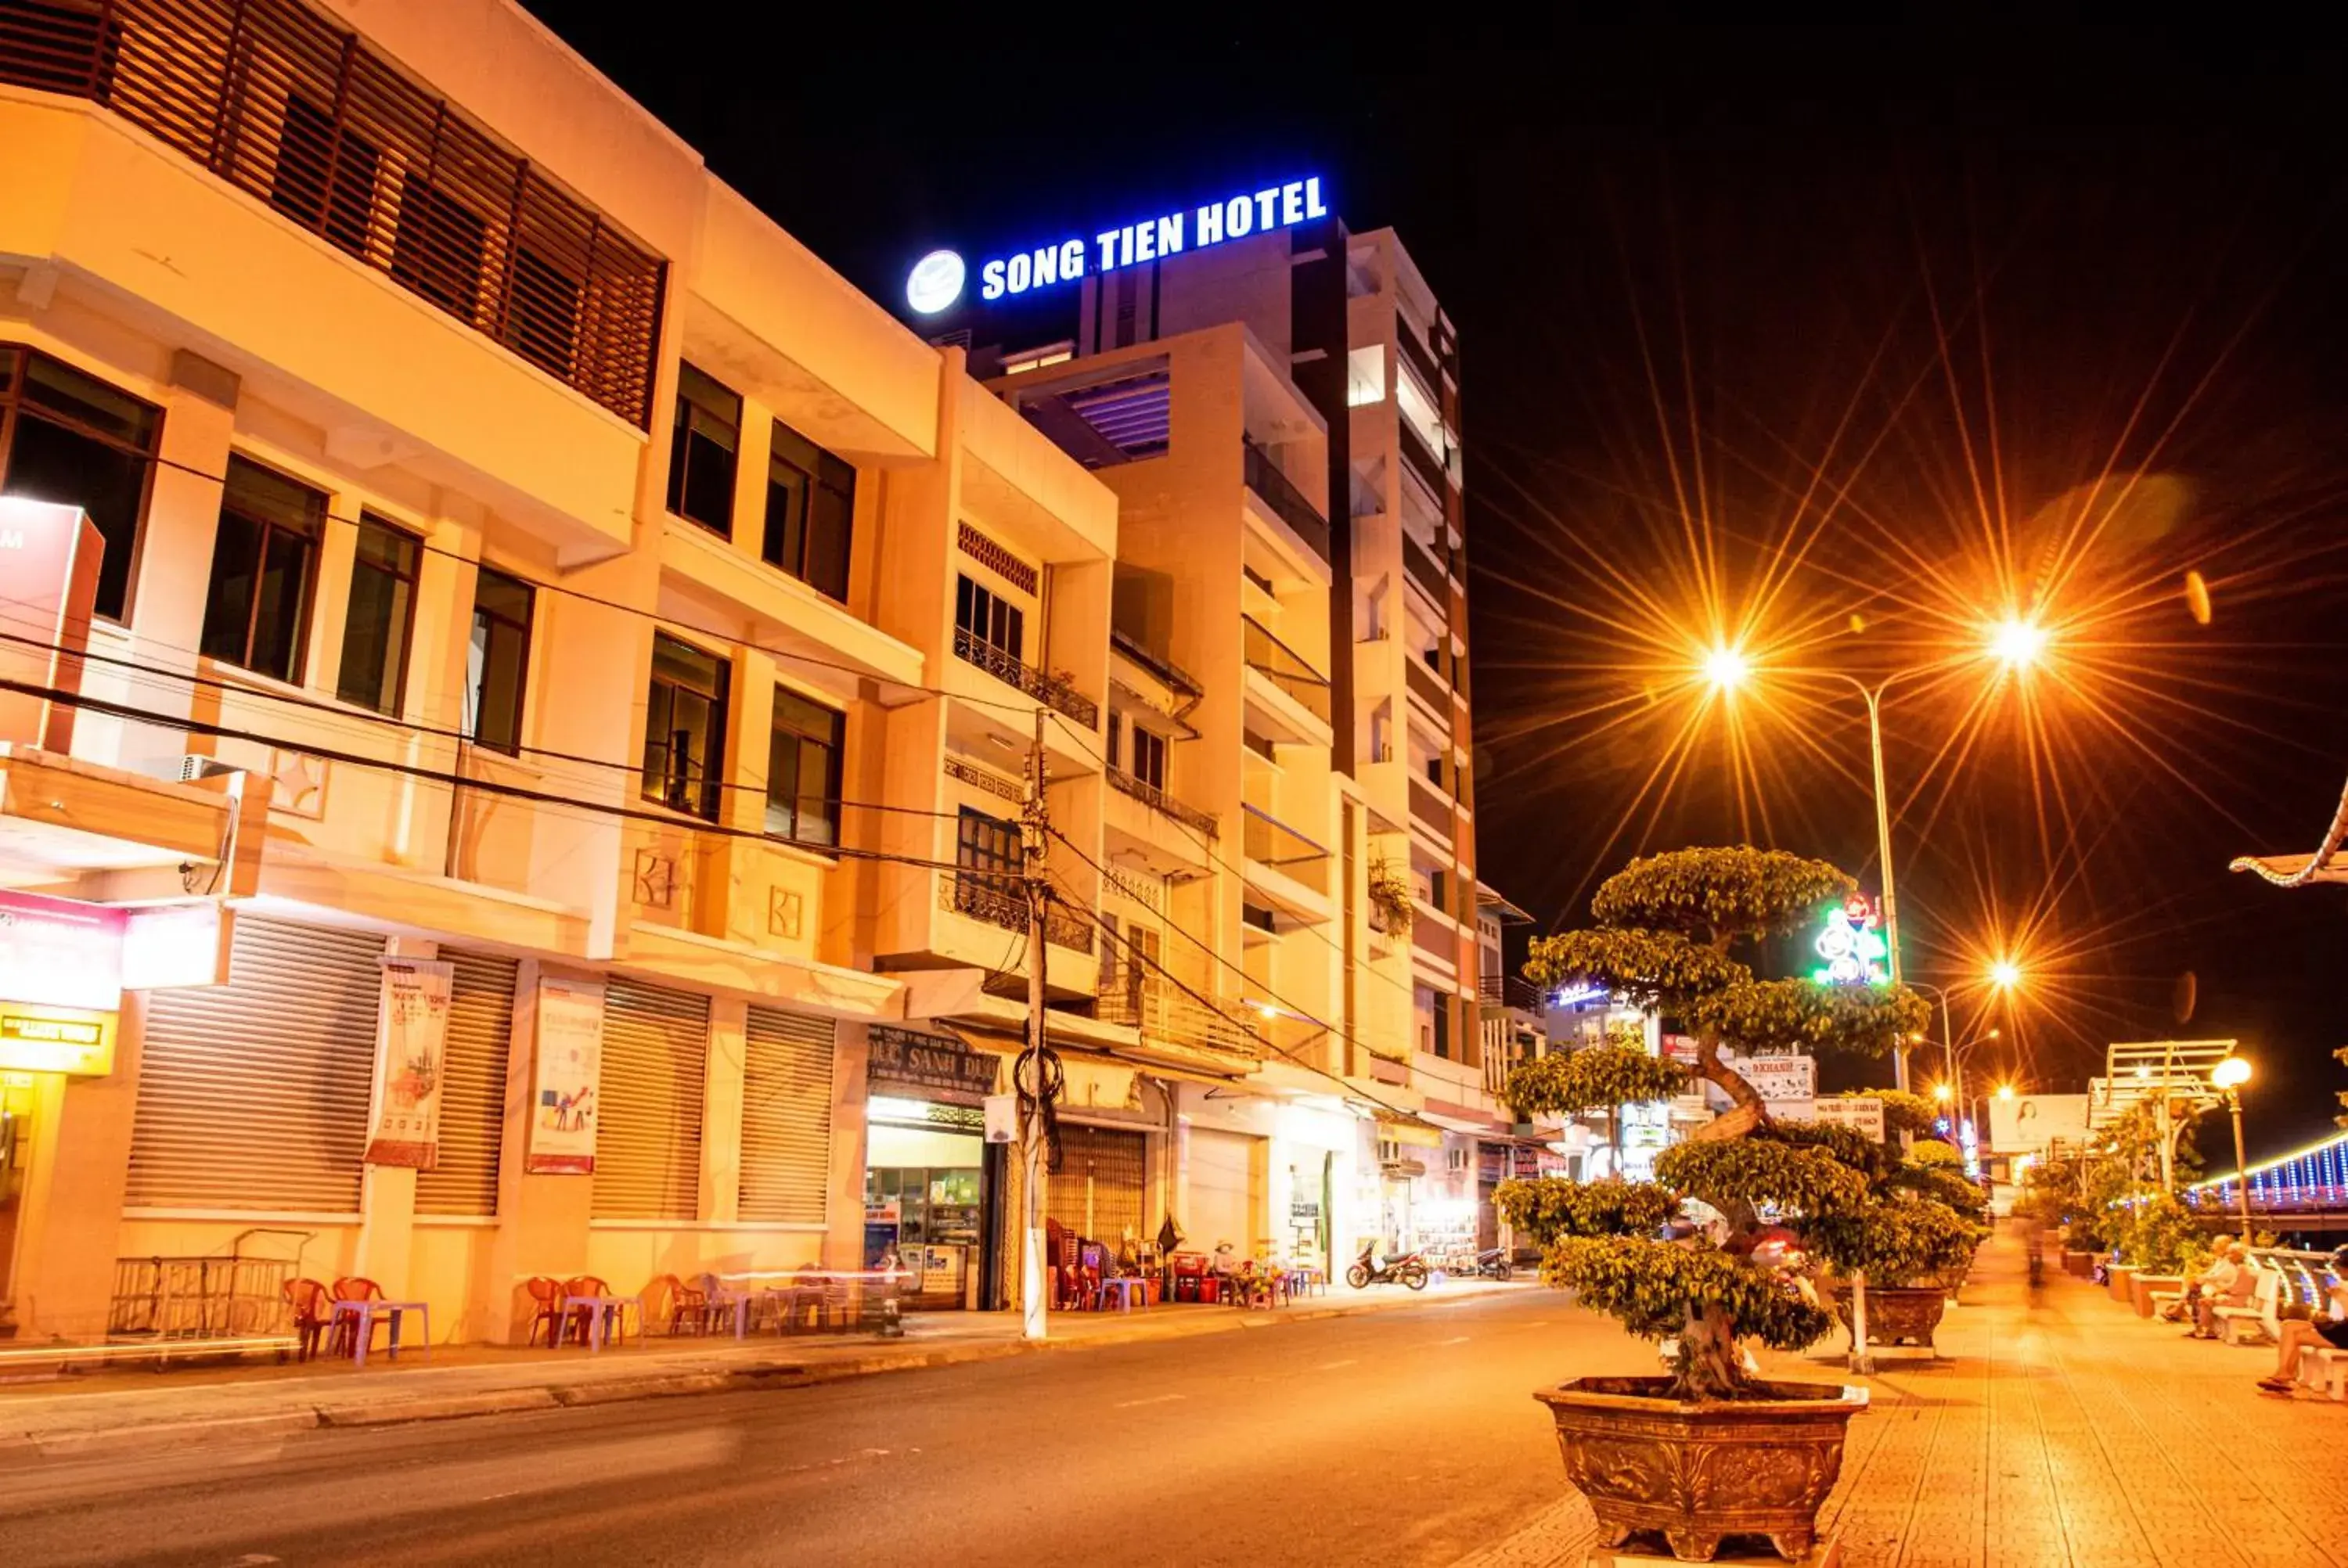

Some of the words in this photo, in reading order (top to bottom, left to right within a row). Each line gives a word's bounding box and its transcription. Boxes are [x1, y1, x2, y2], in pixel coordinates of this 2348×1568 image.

[981, 239, 1085, 300] SONG
[1097, 213, 1183, 272] TIEN
[1196, 177, 1327, 246] HOTEL
[909, 1048, 956, 1073] SANH
